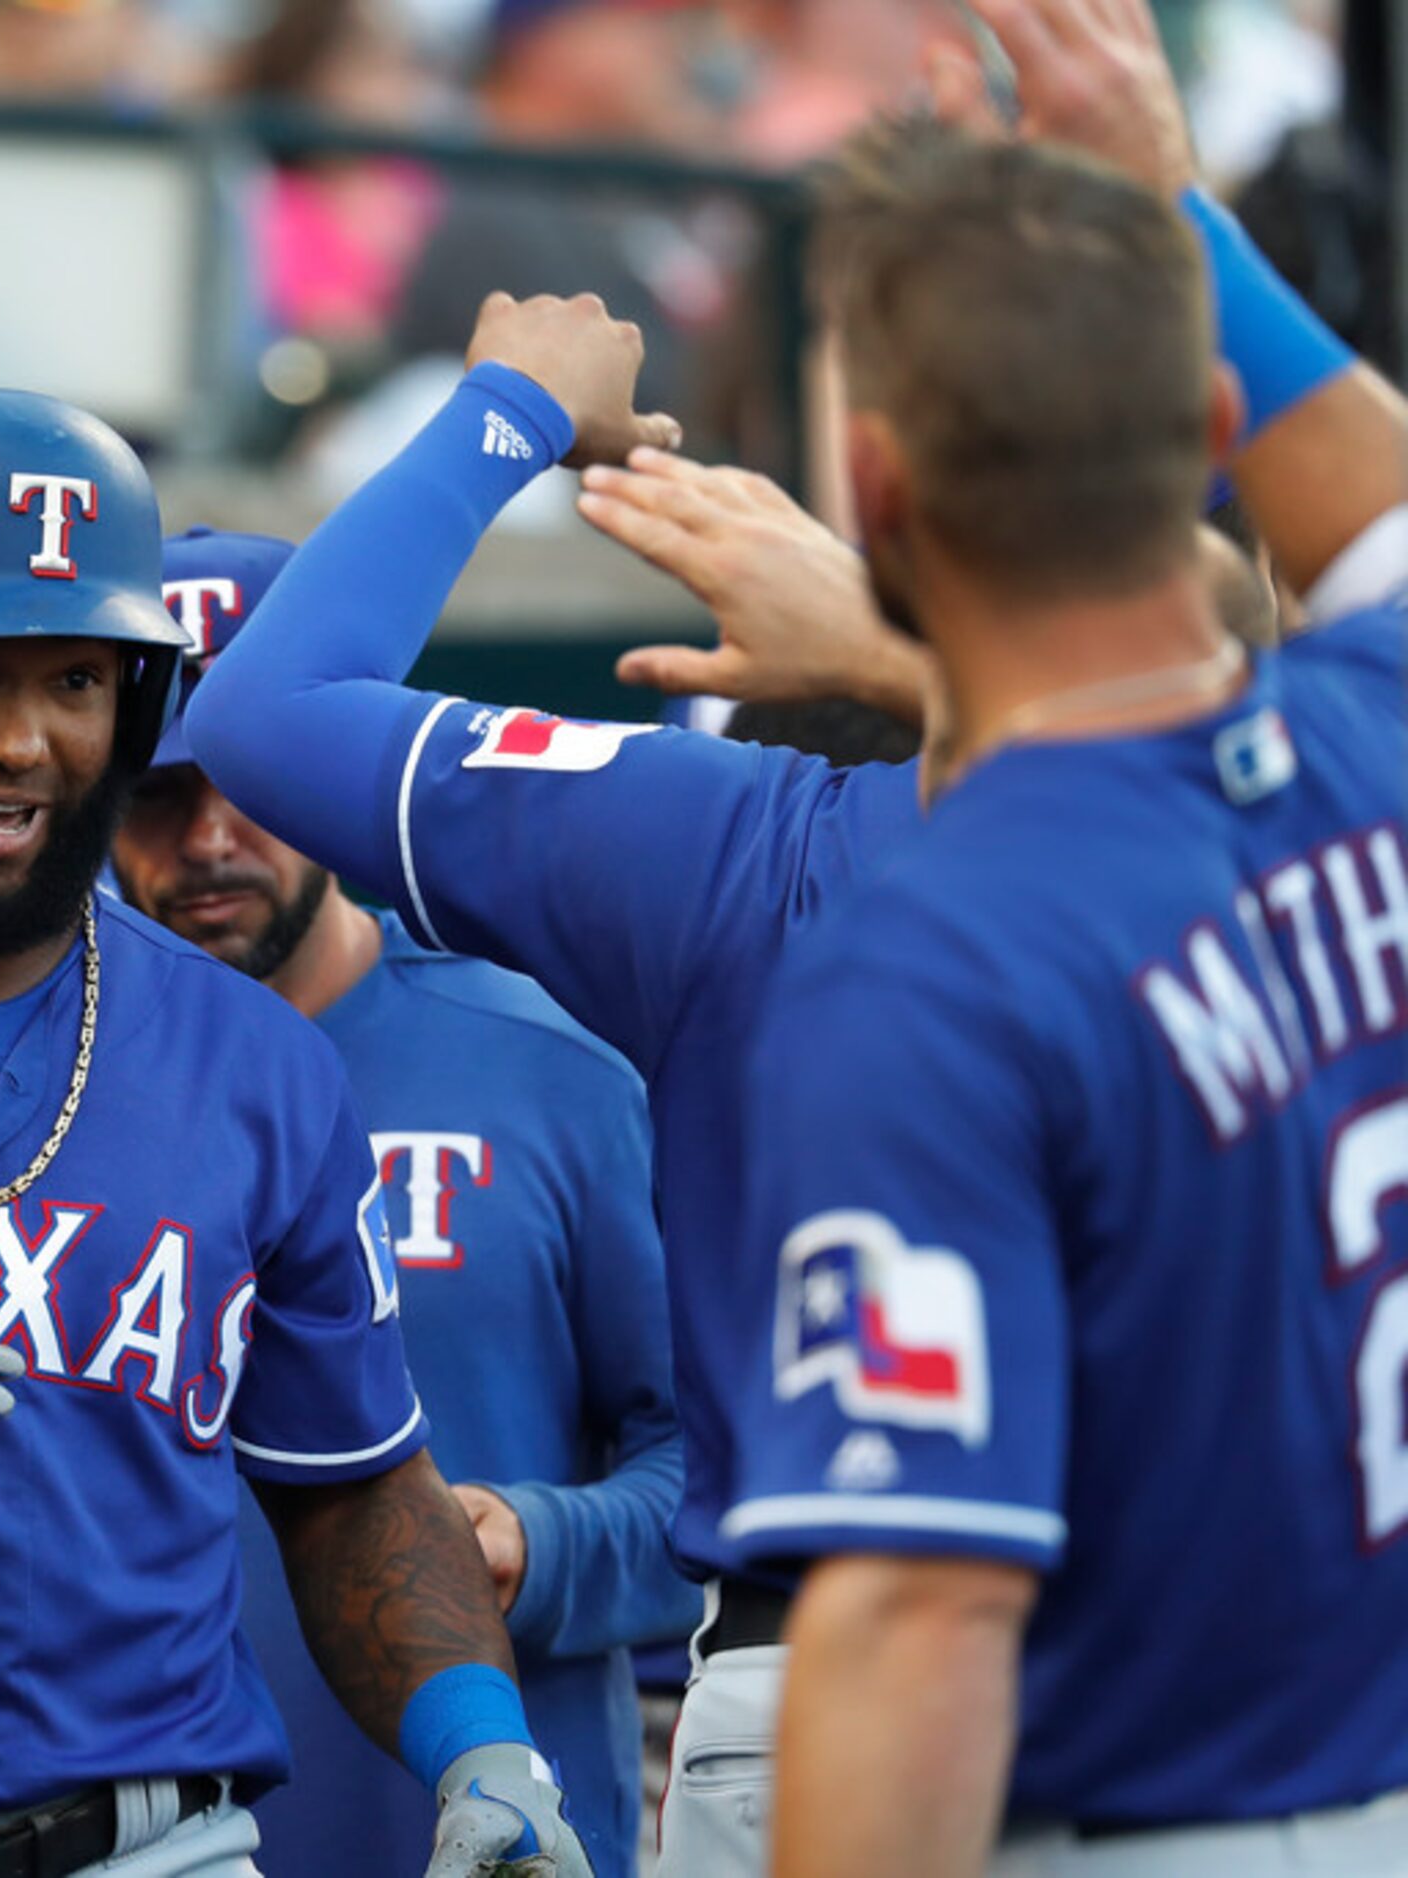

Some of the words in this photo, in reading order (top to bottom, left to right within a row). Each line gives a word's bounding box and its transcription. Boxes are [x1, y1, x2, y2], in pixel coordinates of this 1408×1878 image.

[8, 471, 99, 582] T
[161, 576, 244, 668] T
[368, 1129, 494, 1271] T
